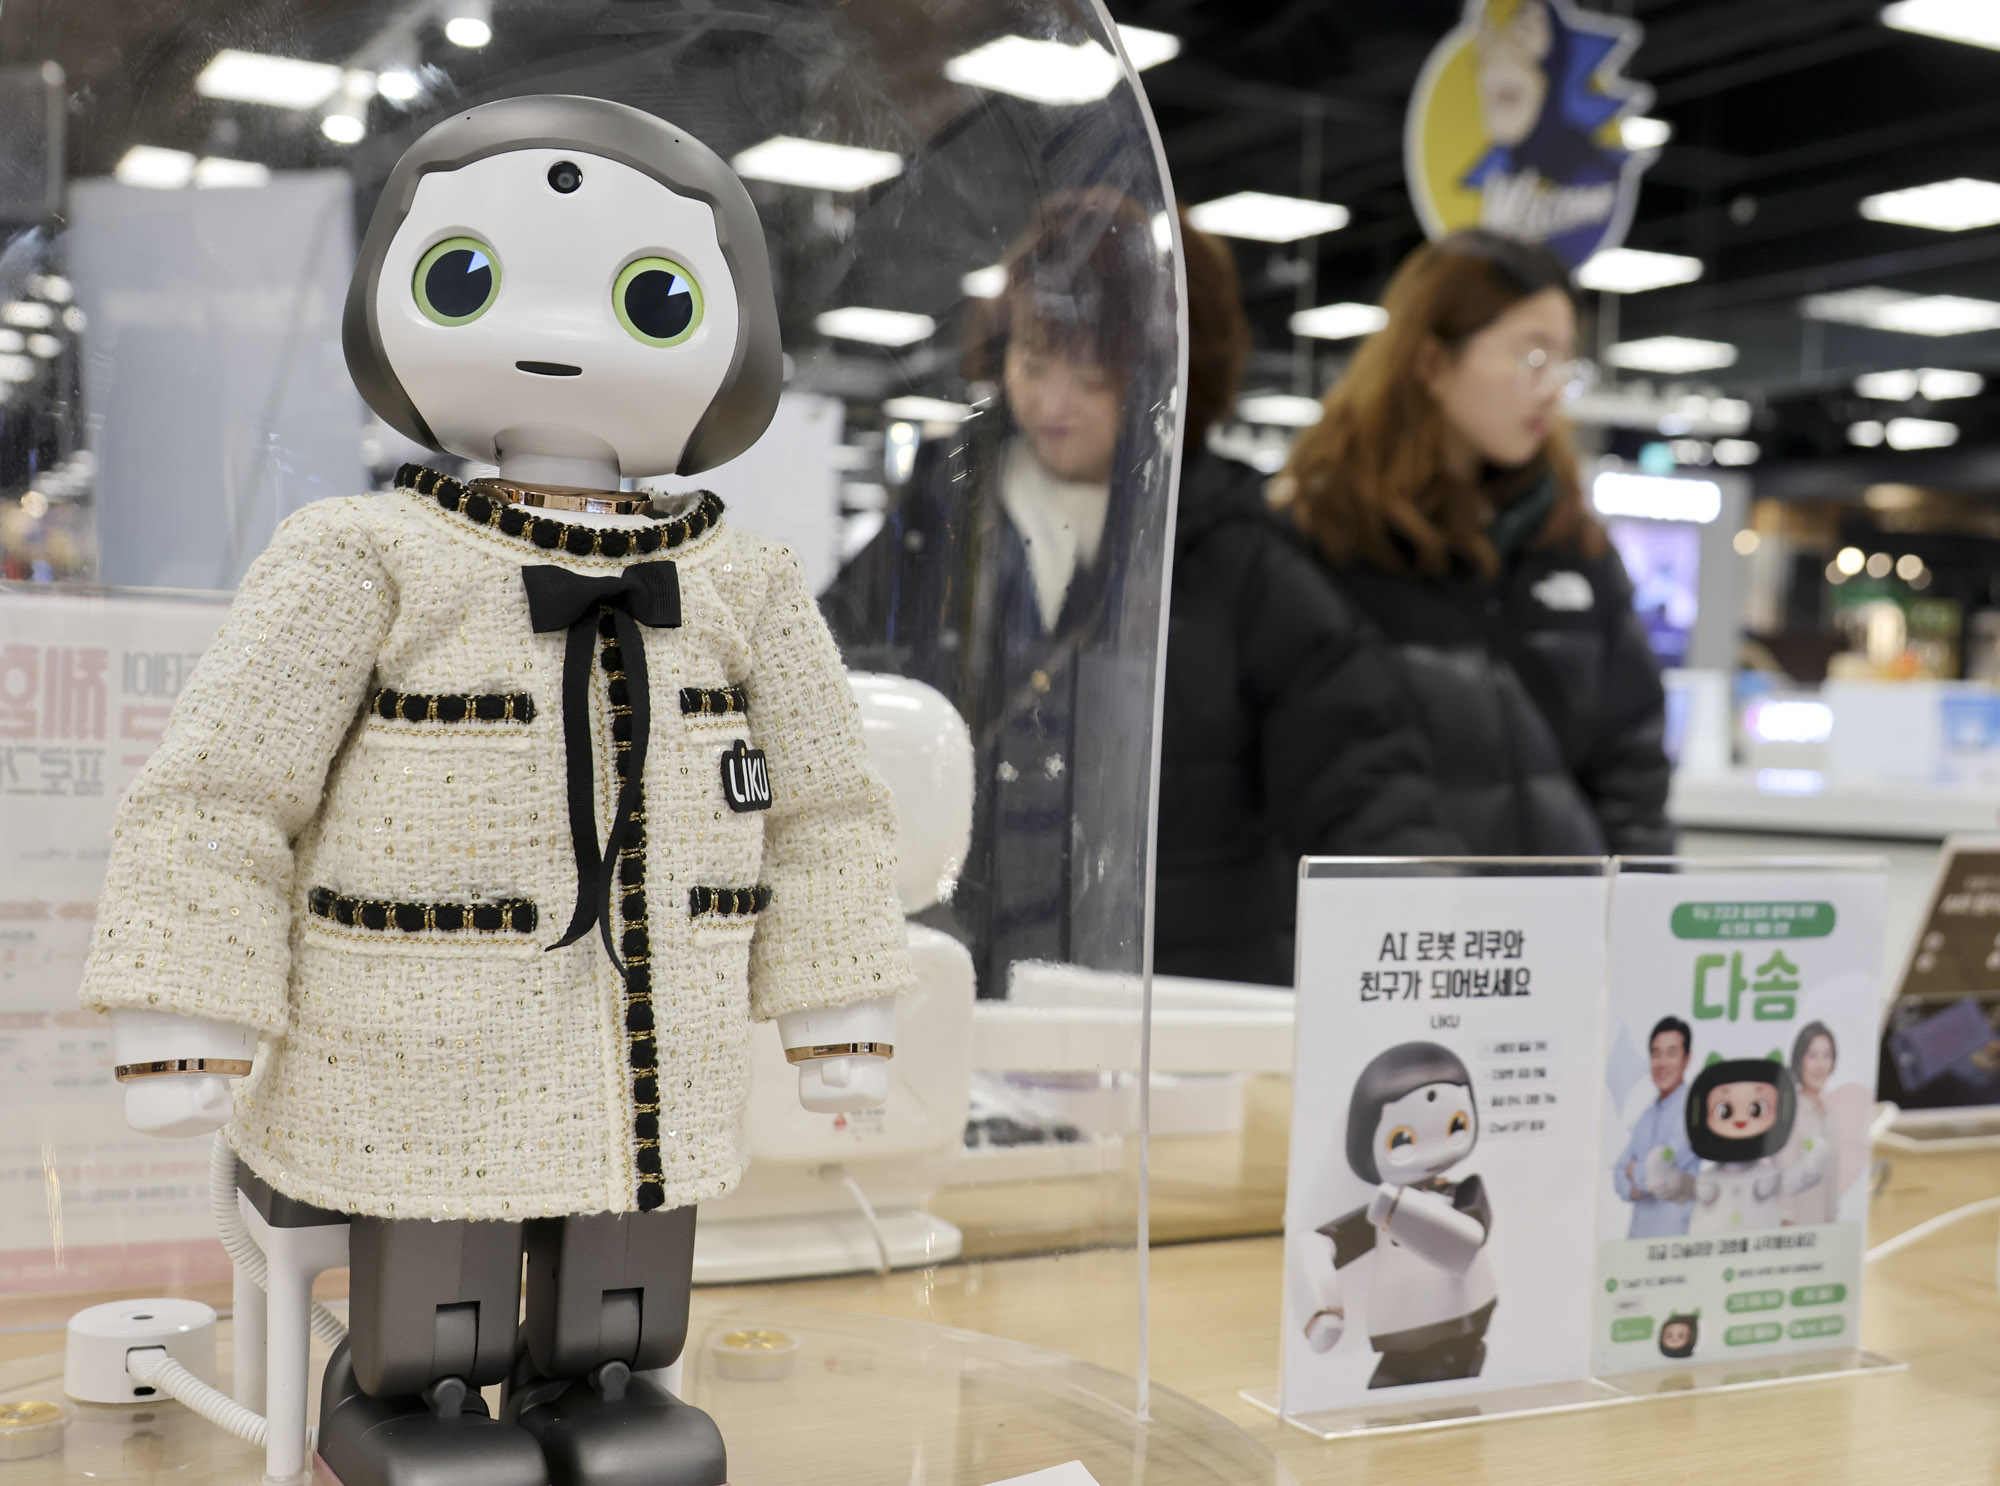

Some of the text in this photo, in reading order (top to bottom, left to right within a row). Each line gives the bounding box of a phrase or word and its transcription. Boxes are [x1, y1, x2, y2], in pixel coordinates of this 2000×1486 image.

[1379, 929, 1526, 961] AI 로봇 리쿠와
[1360, 967, 1531, 1002] 친구가 되어보세요
[1692, 948, 1800, 1023] 다솜
